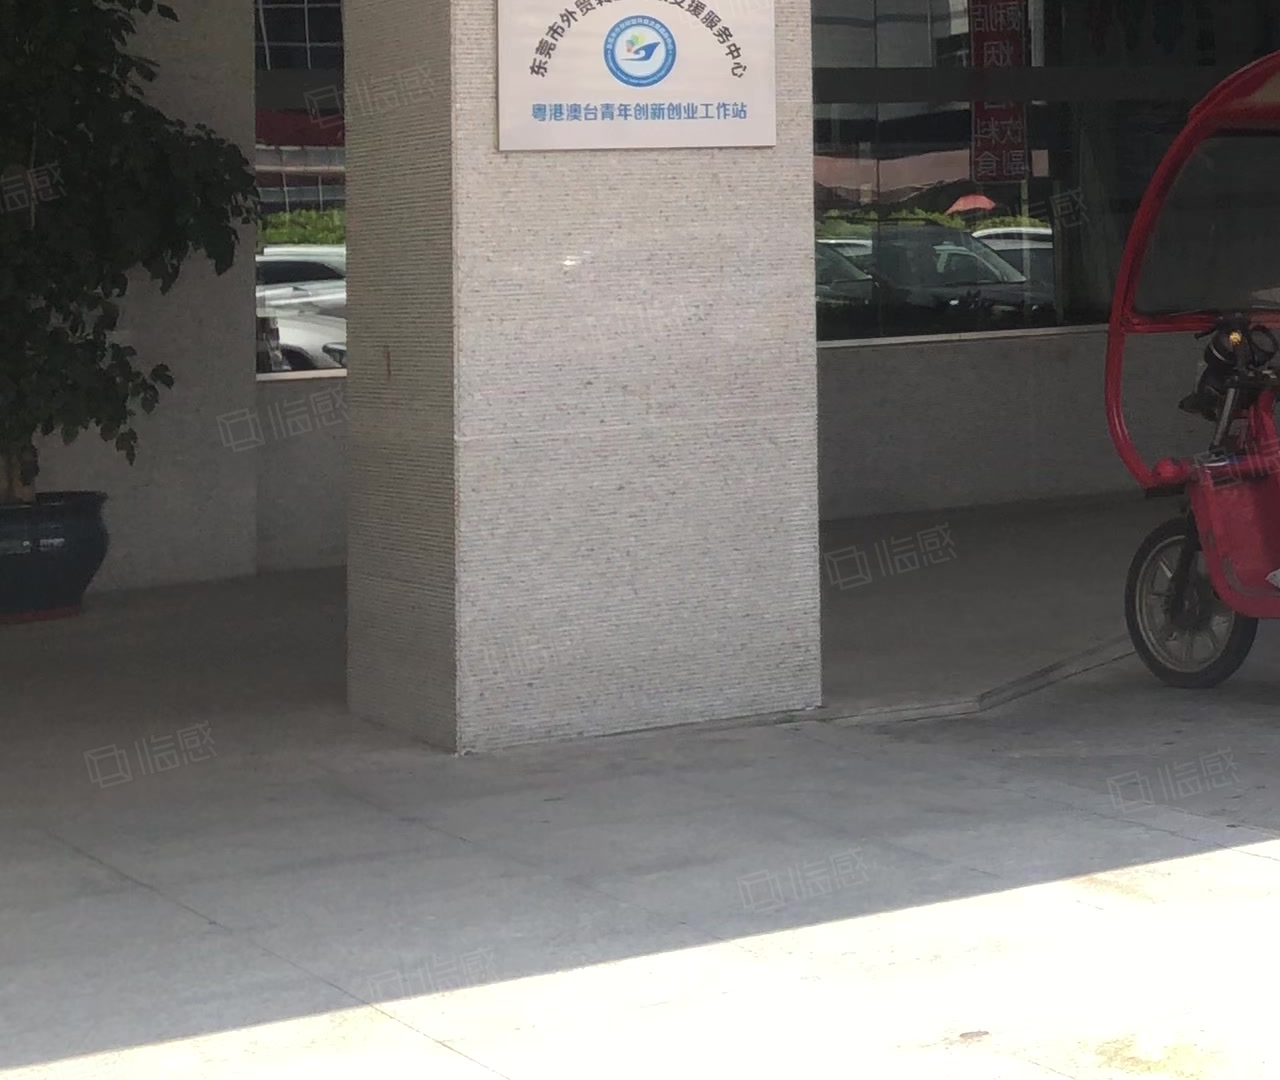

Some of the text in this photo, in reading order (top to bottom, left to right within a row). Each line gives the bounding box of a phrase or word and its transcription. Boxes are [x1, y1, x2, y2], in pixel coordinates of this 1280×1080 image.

[531, 102, 748, 122] 粤港澳台青年创新创业工作站
